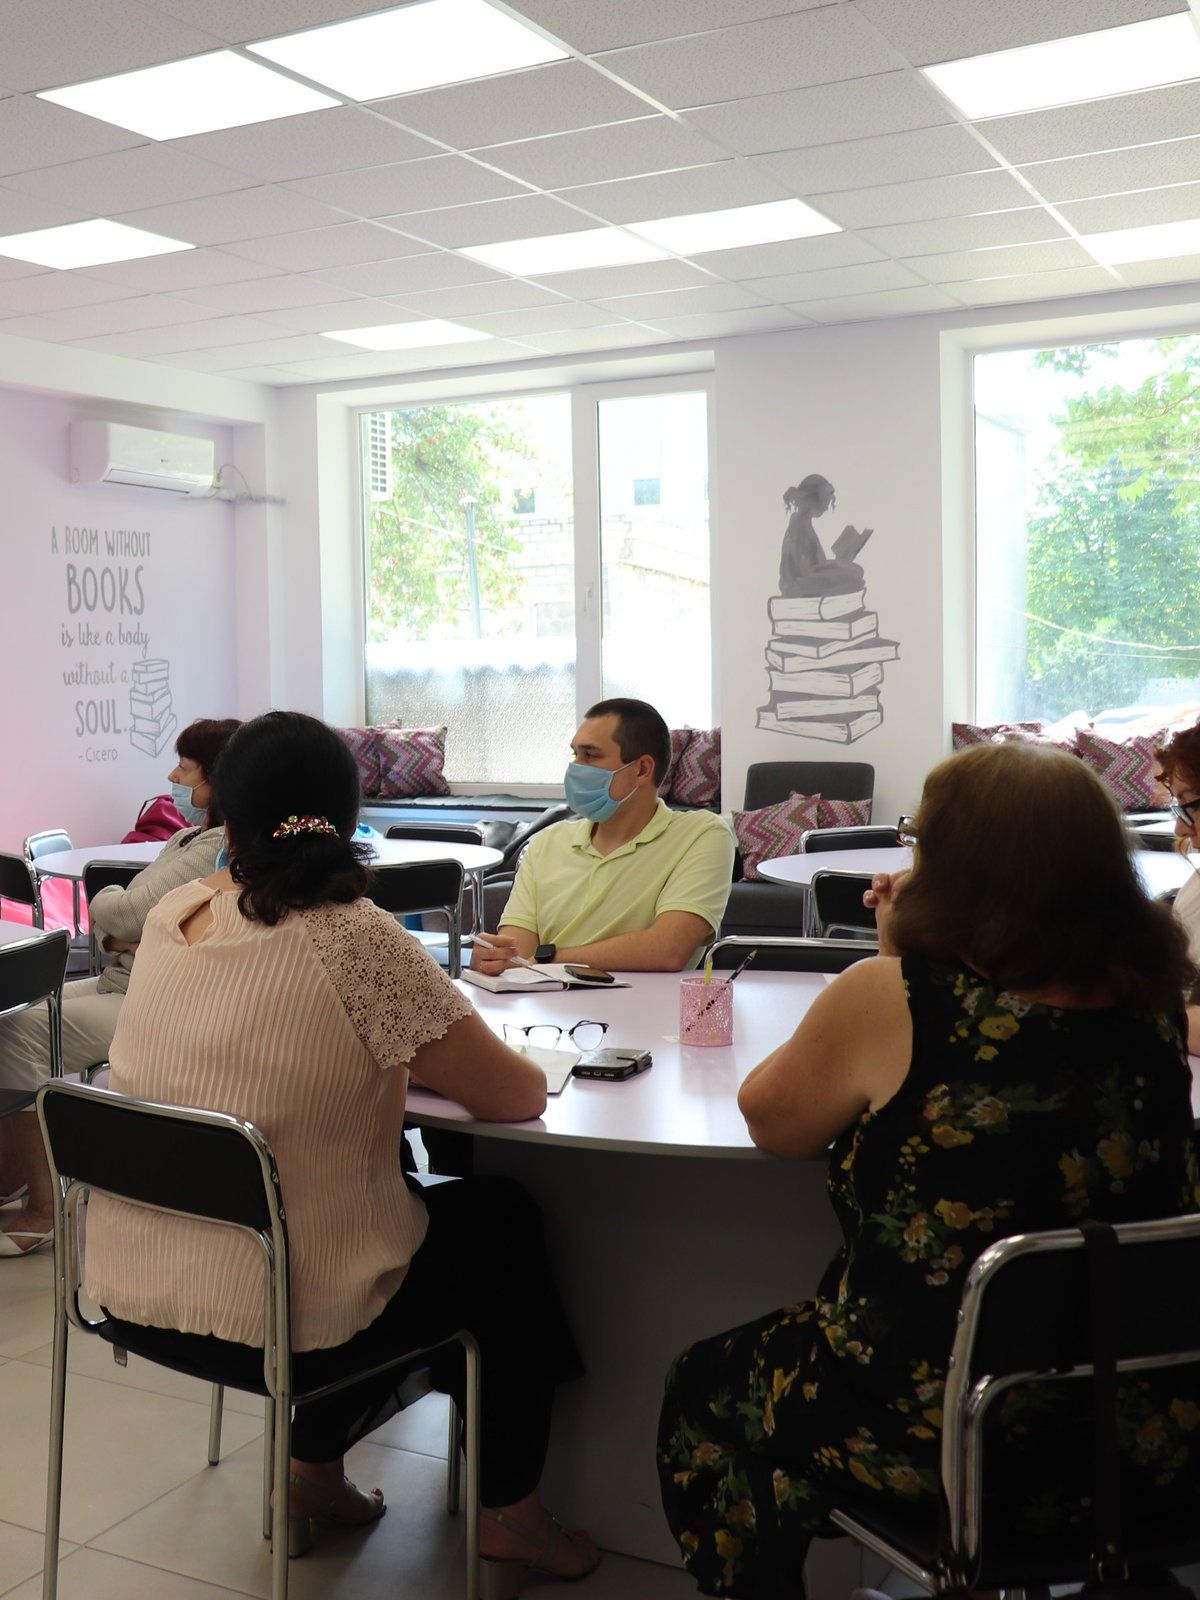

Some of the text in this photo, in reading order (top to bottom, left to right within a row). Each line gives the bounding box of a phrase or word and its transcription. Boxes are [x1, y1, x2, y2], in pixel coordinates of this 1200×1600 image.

[51, 525, 151, 557] A ROOM WITHOUT
[66, 563, 145, 616] BOOKS
[61, 622, 150, 659] is like a body
[62, 660, 130, 686] without a
